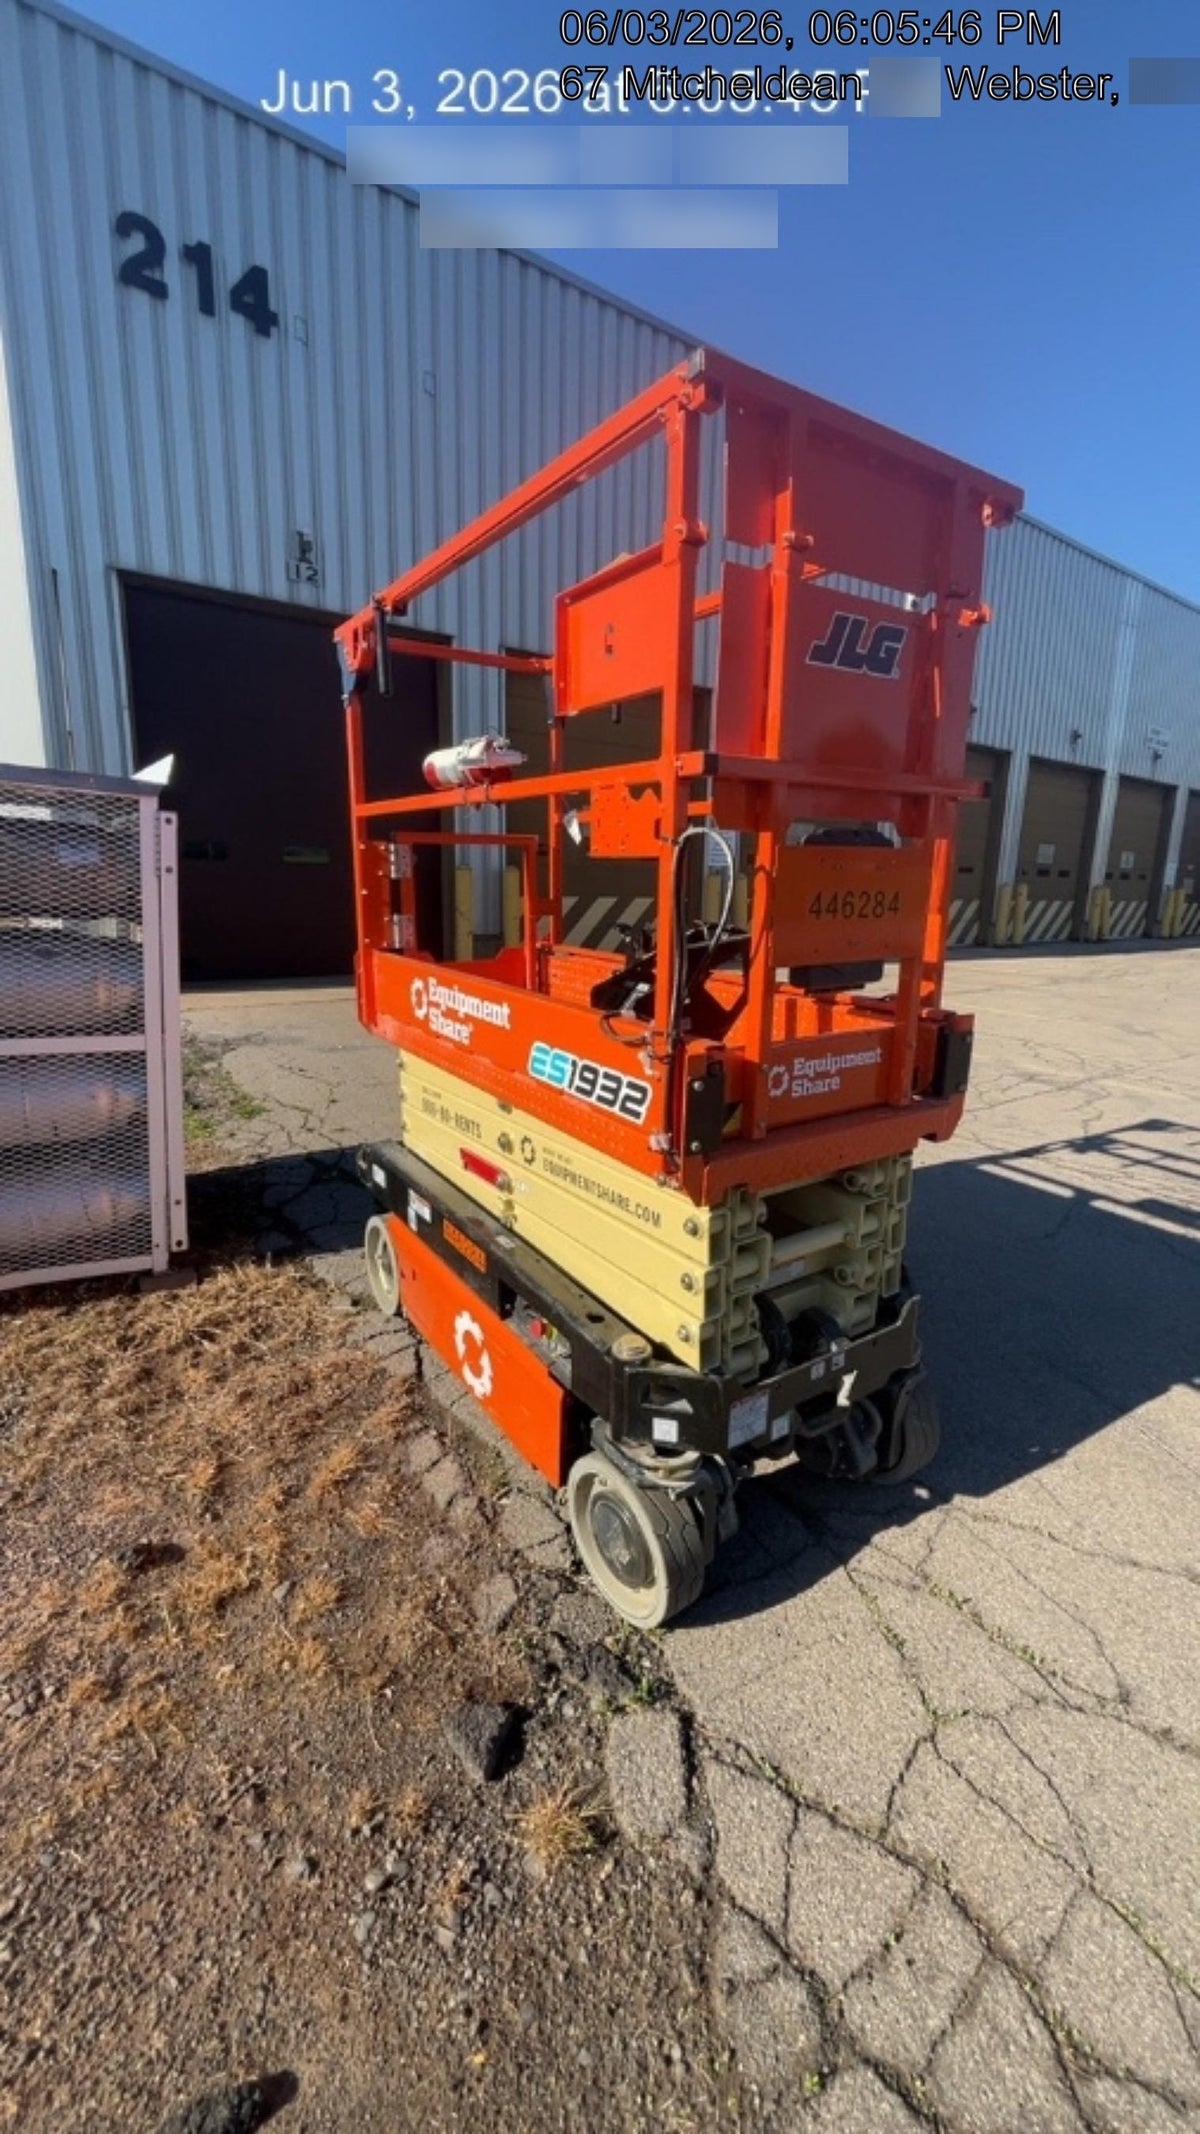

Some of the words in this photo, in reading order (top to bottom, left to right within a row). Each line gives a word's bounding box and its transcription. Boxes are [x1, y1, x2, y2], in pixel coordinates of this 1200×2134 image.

[115, 210, 279, 338] 214
[806, 609, 908, 679] JLG
[807, 890, 901, 920] 446284
[427, 976, 511, 1030] Equipment
[528, 1042, 652, 1123] ES1932
[791, 1076, 841, 1098] Share
[792, 1048, 882, 1077] Equipment
